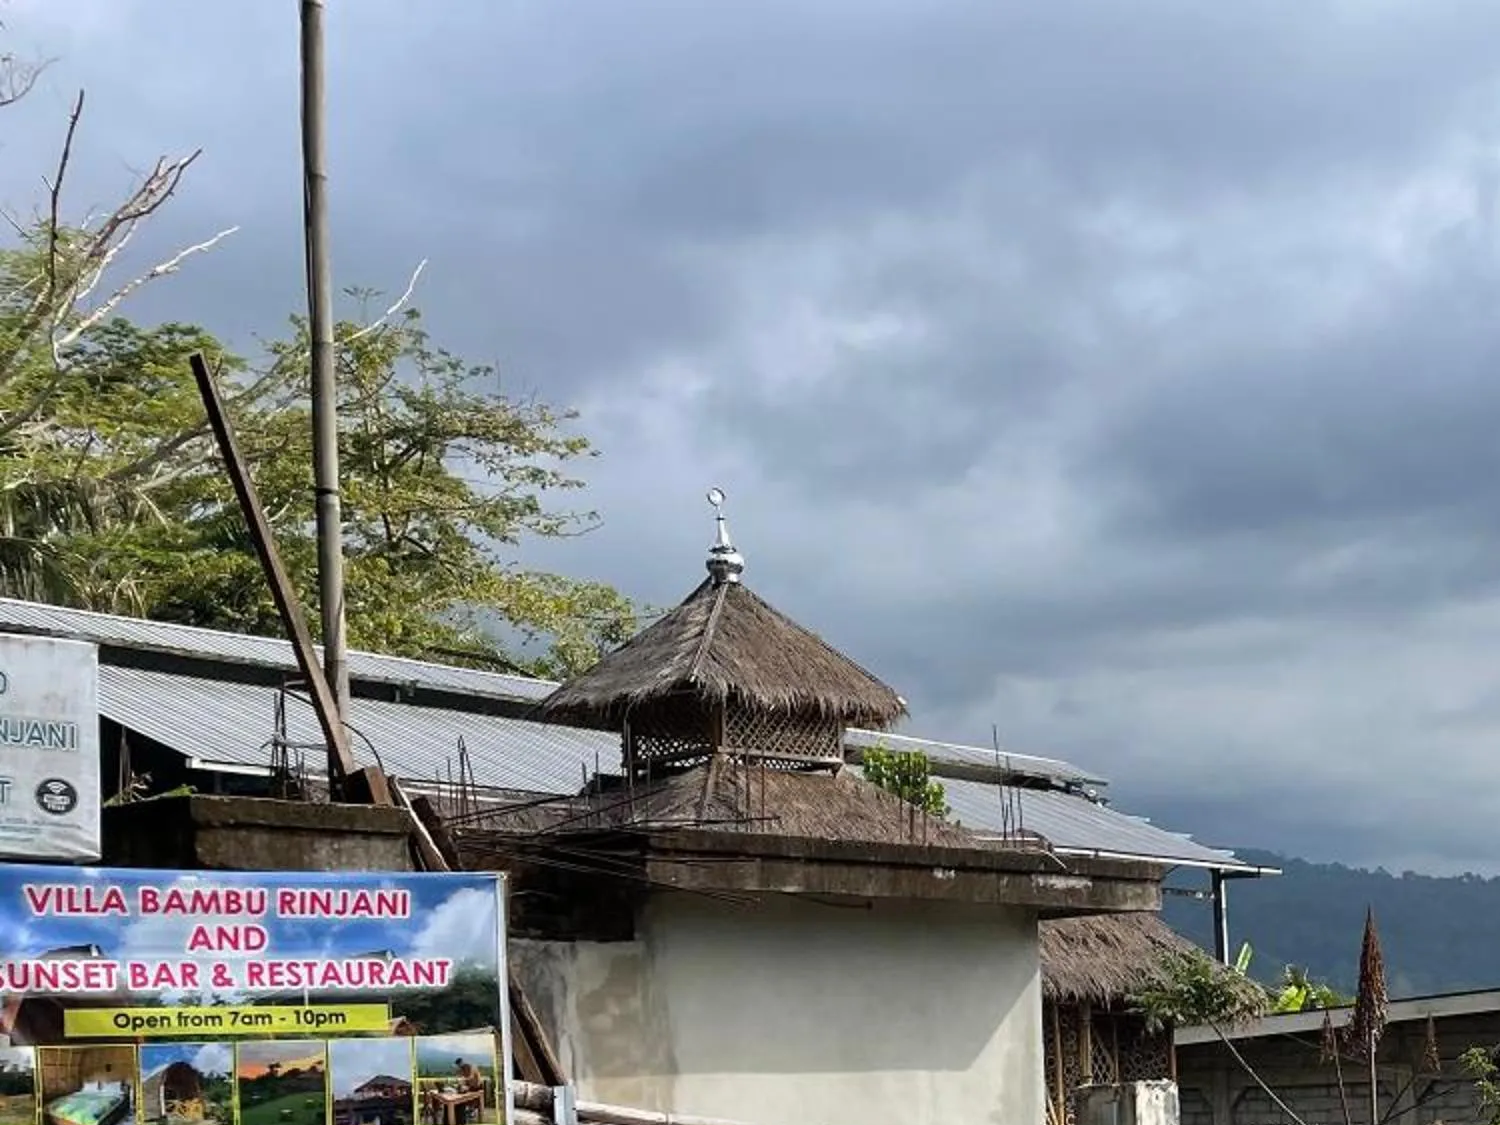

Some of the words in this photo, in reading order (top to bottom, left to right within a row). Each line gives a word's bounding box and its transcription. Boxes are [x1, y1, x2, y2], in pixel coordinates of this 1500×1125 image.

[25, 886, 128, 914] VILLA
[140, 888, 266, 915] BAMBU
[279, 890, 408, 917] RINJANI
[188, 925, 267, 951] AND
[0, 962, 117, 989] UNSET
[130, 962, 199, 989] BAR
[211, 962, 235, 988] &
[247, 960, 450, 987] RESTAURANT
[113, 1012, 171, 1031] Open
[177, 1011, 223, 1027] from
[230, 1011, 273, 1026] 7am
[294, 1010, 347, 1028] 10pm
